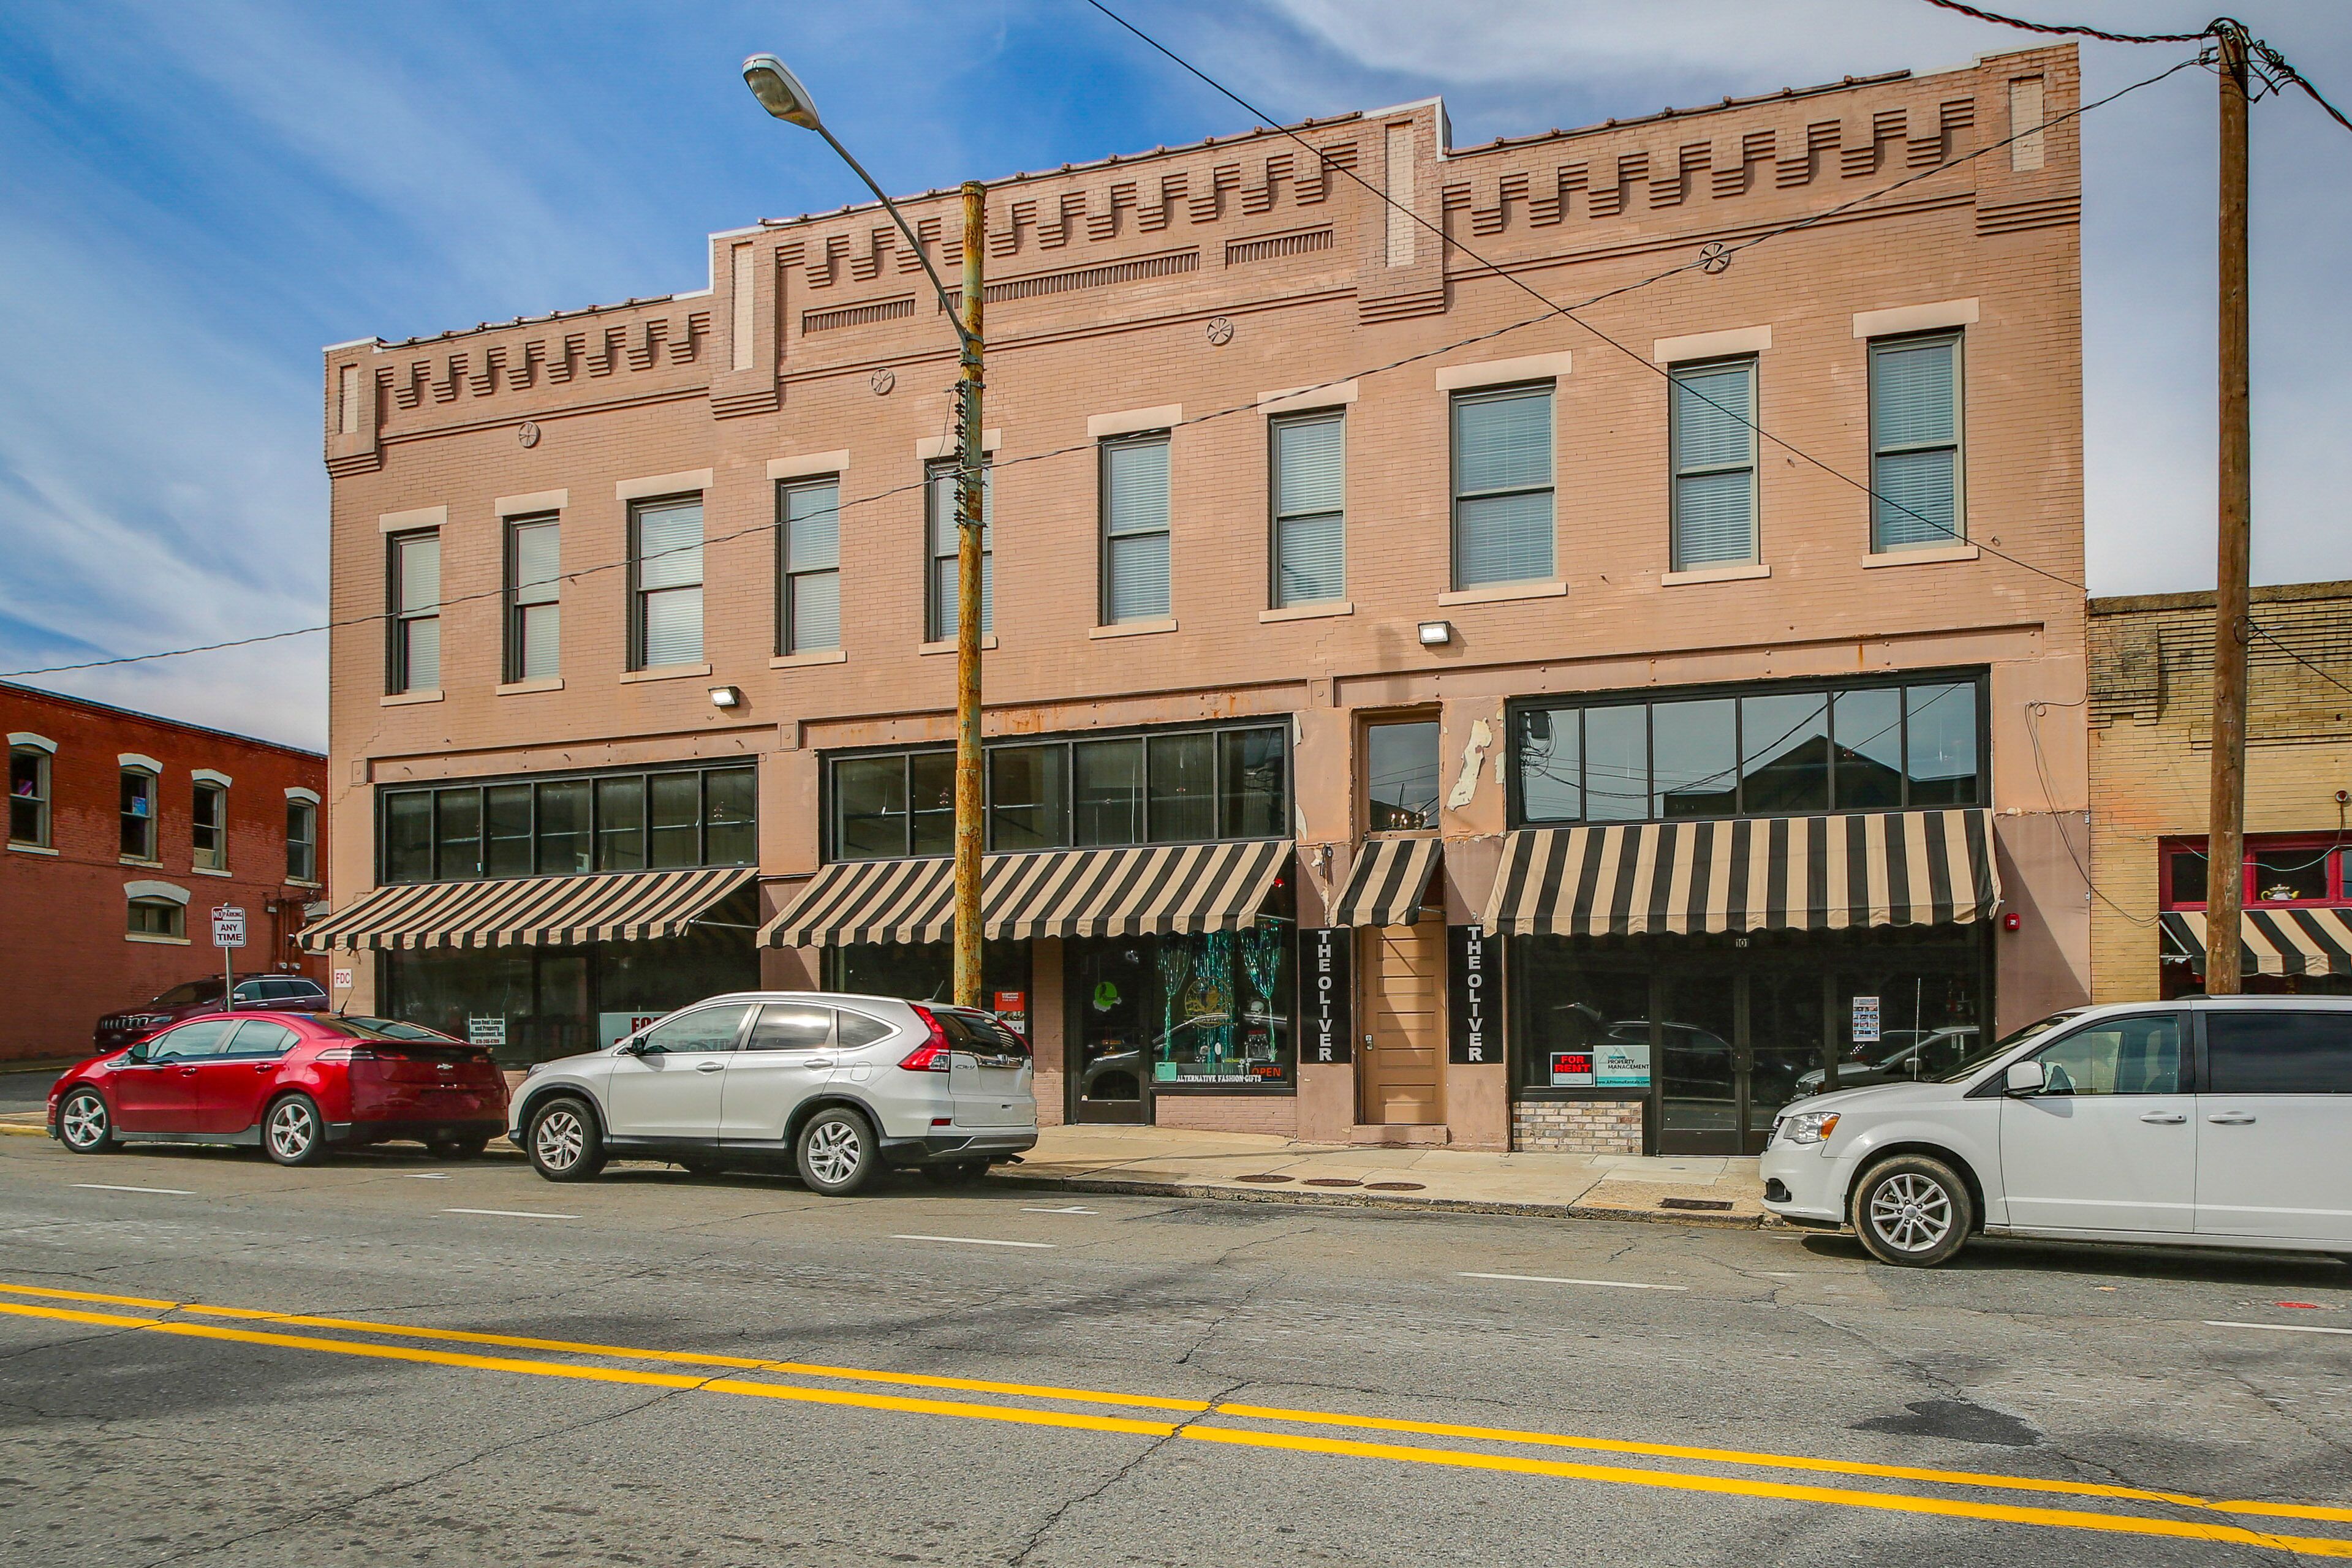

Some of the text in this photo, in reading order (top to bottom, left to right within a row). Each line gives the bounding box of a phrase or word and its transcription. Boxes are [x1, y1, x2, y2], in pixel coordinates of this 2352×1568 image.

[214, 910, 222, 919] NO
[216, 933, 243, 941] TIME
[336, 972, 350, 984] FDC
[1317, 930, 1333, 1061] THE OLIVER
[1467, 926, 1483, 1061] THE OLIVER
[631, 1017, 662, 1034] FO
[1561, 1055, 1584, 1064] FOR
[1252, 1067, 1281, 1077] OPEN
[1554, 1064, 1591, 1072] RENT
